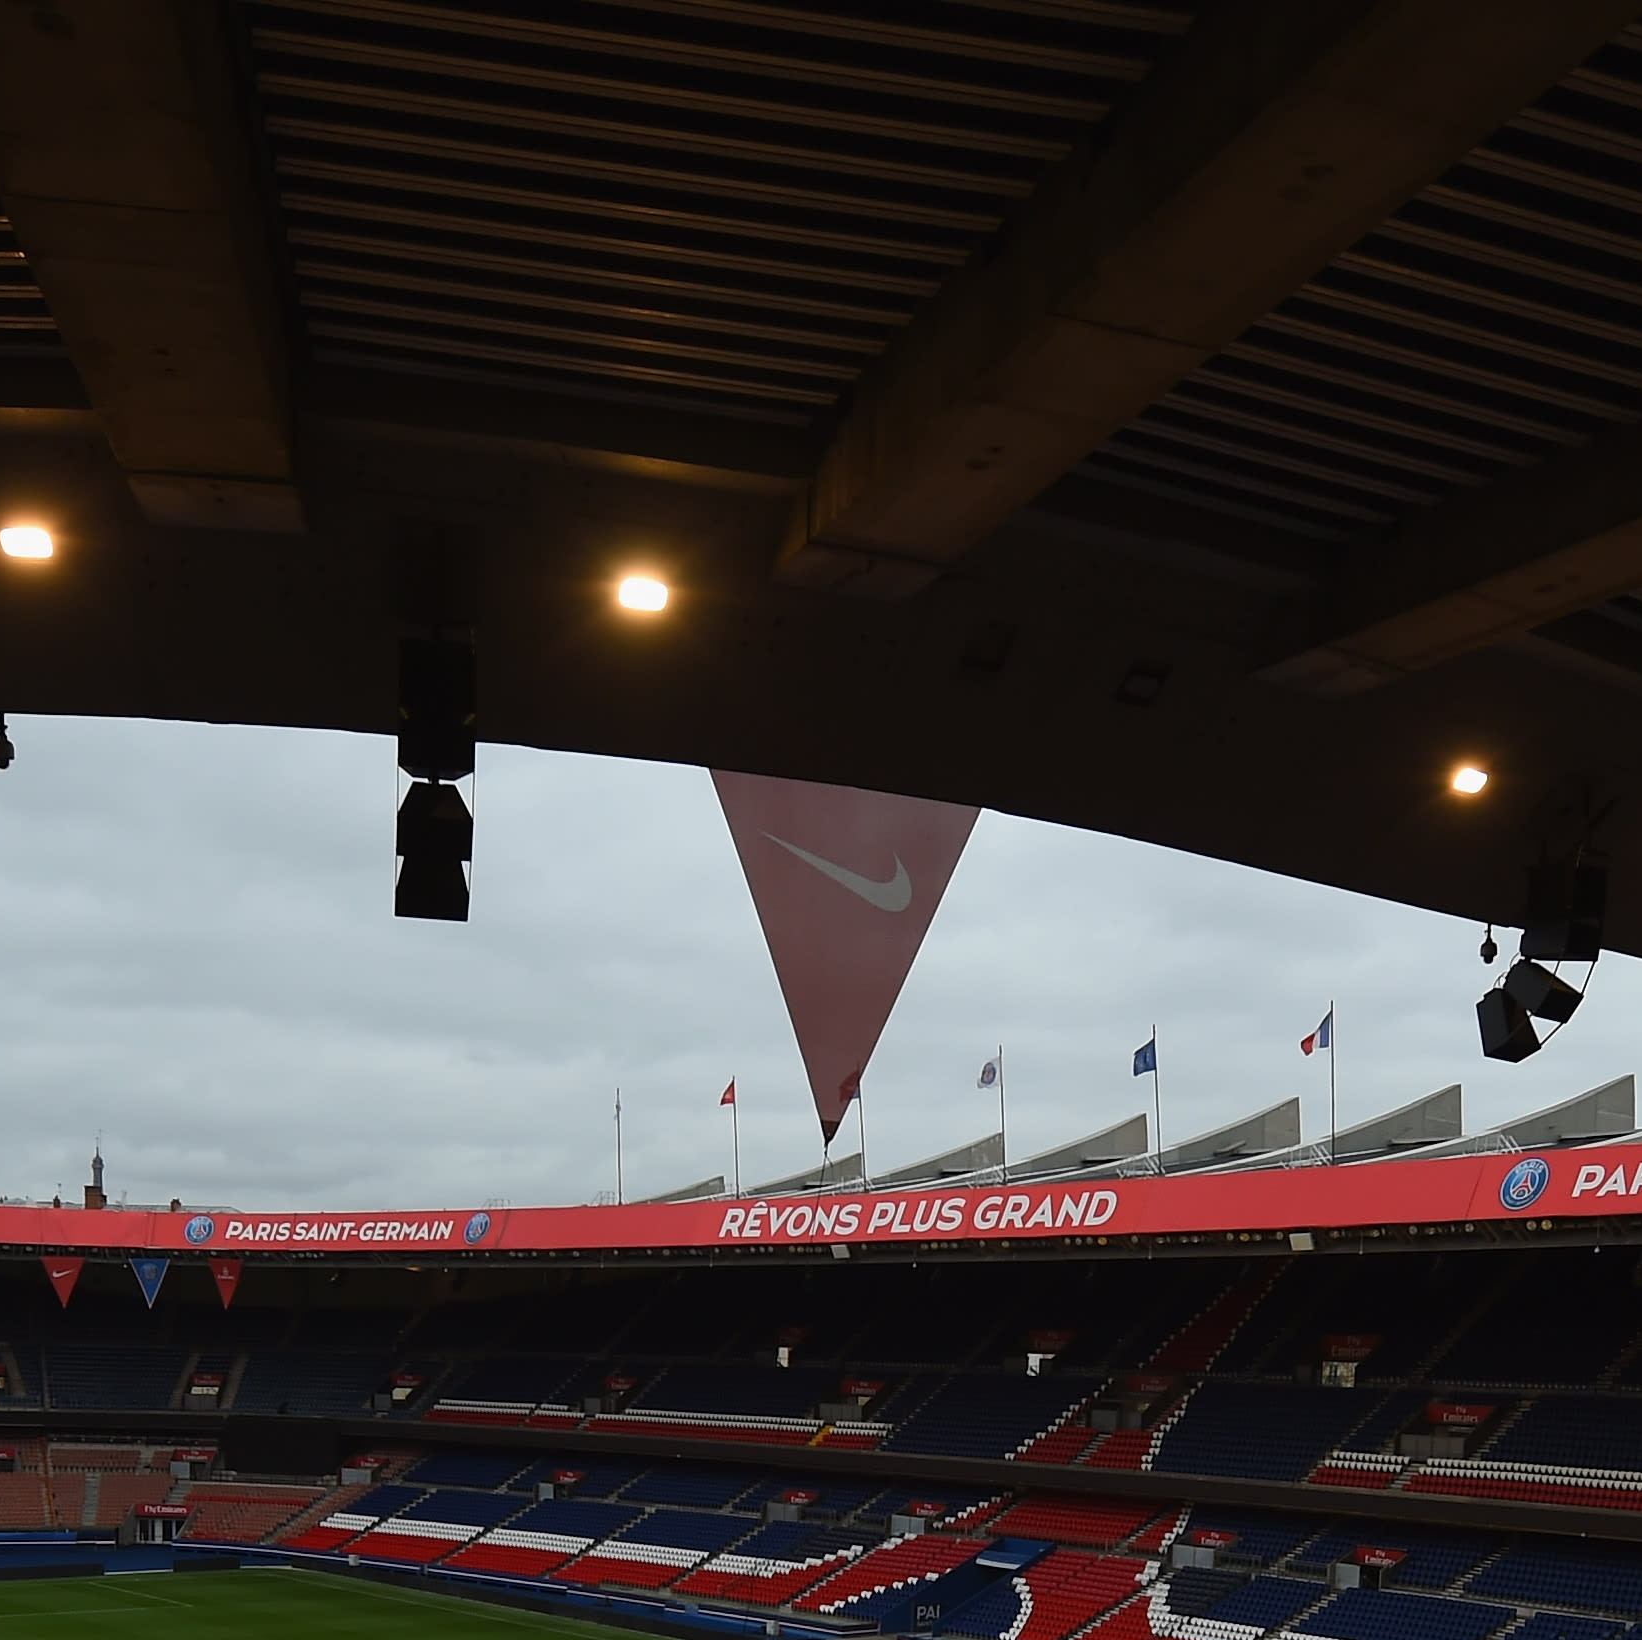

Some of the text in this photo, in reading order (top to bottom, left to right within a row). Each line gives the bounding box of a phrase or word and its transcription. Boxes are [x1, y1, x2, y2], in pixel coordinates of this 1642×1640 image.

[225, 1220, 454, 1241] PARIS SAINT-GERMAIN
[718, 1190, 1118, 1238] RÊVONS PLUS GRAND
